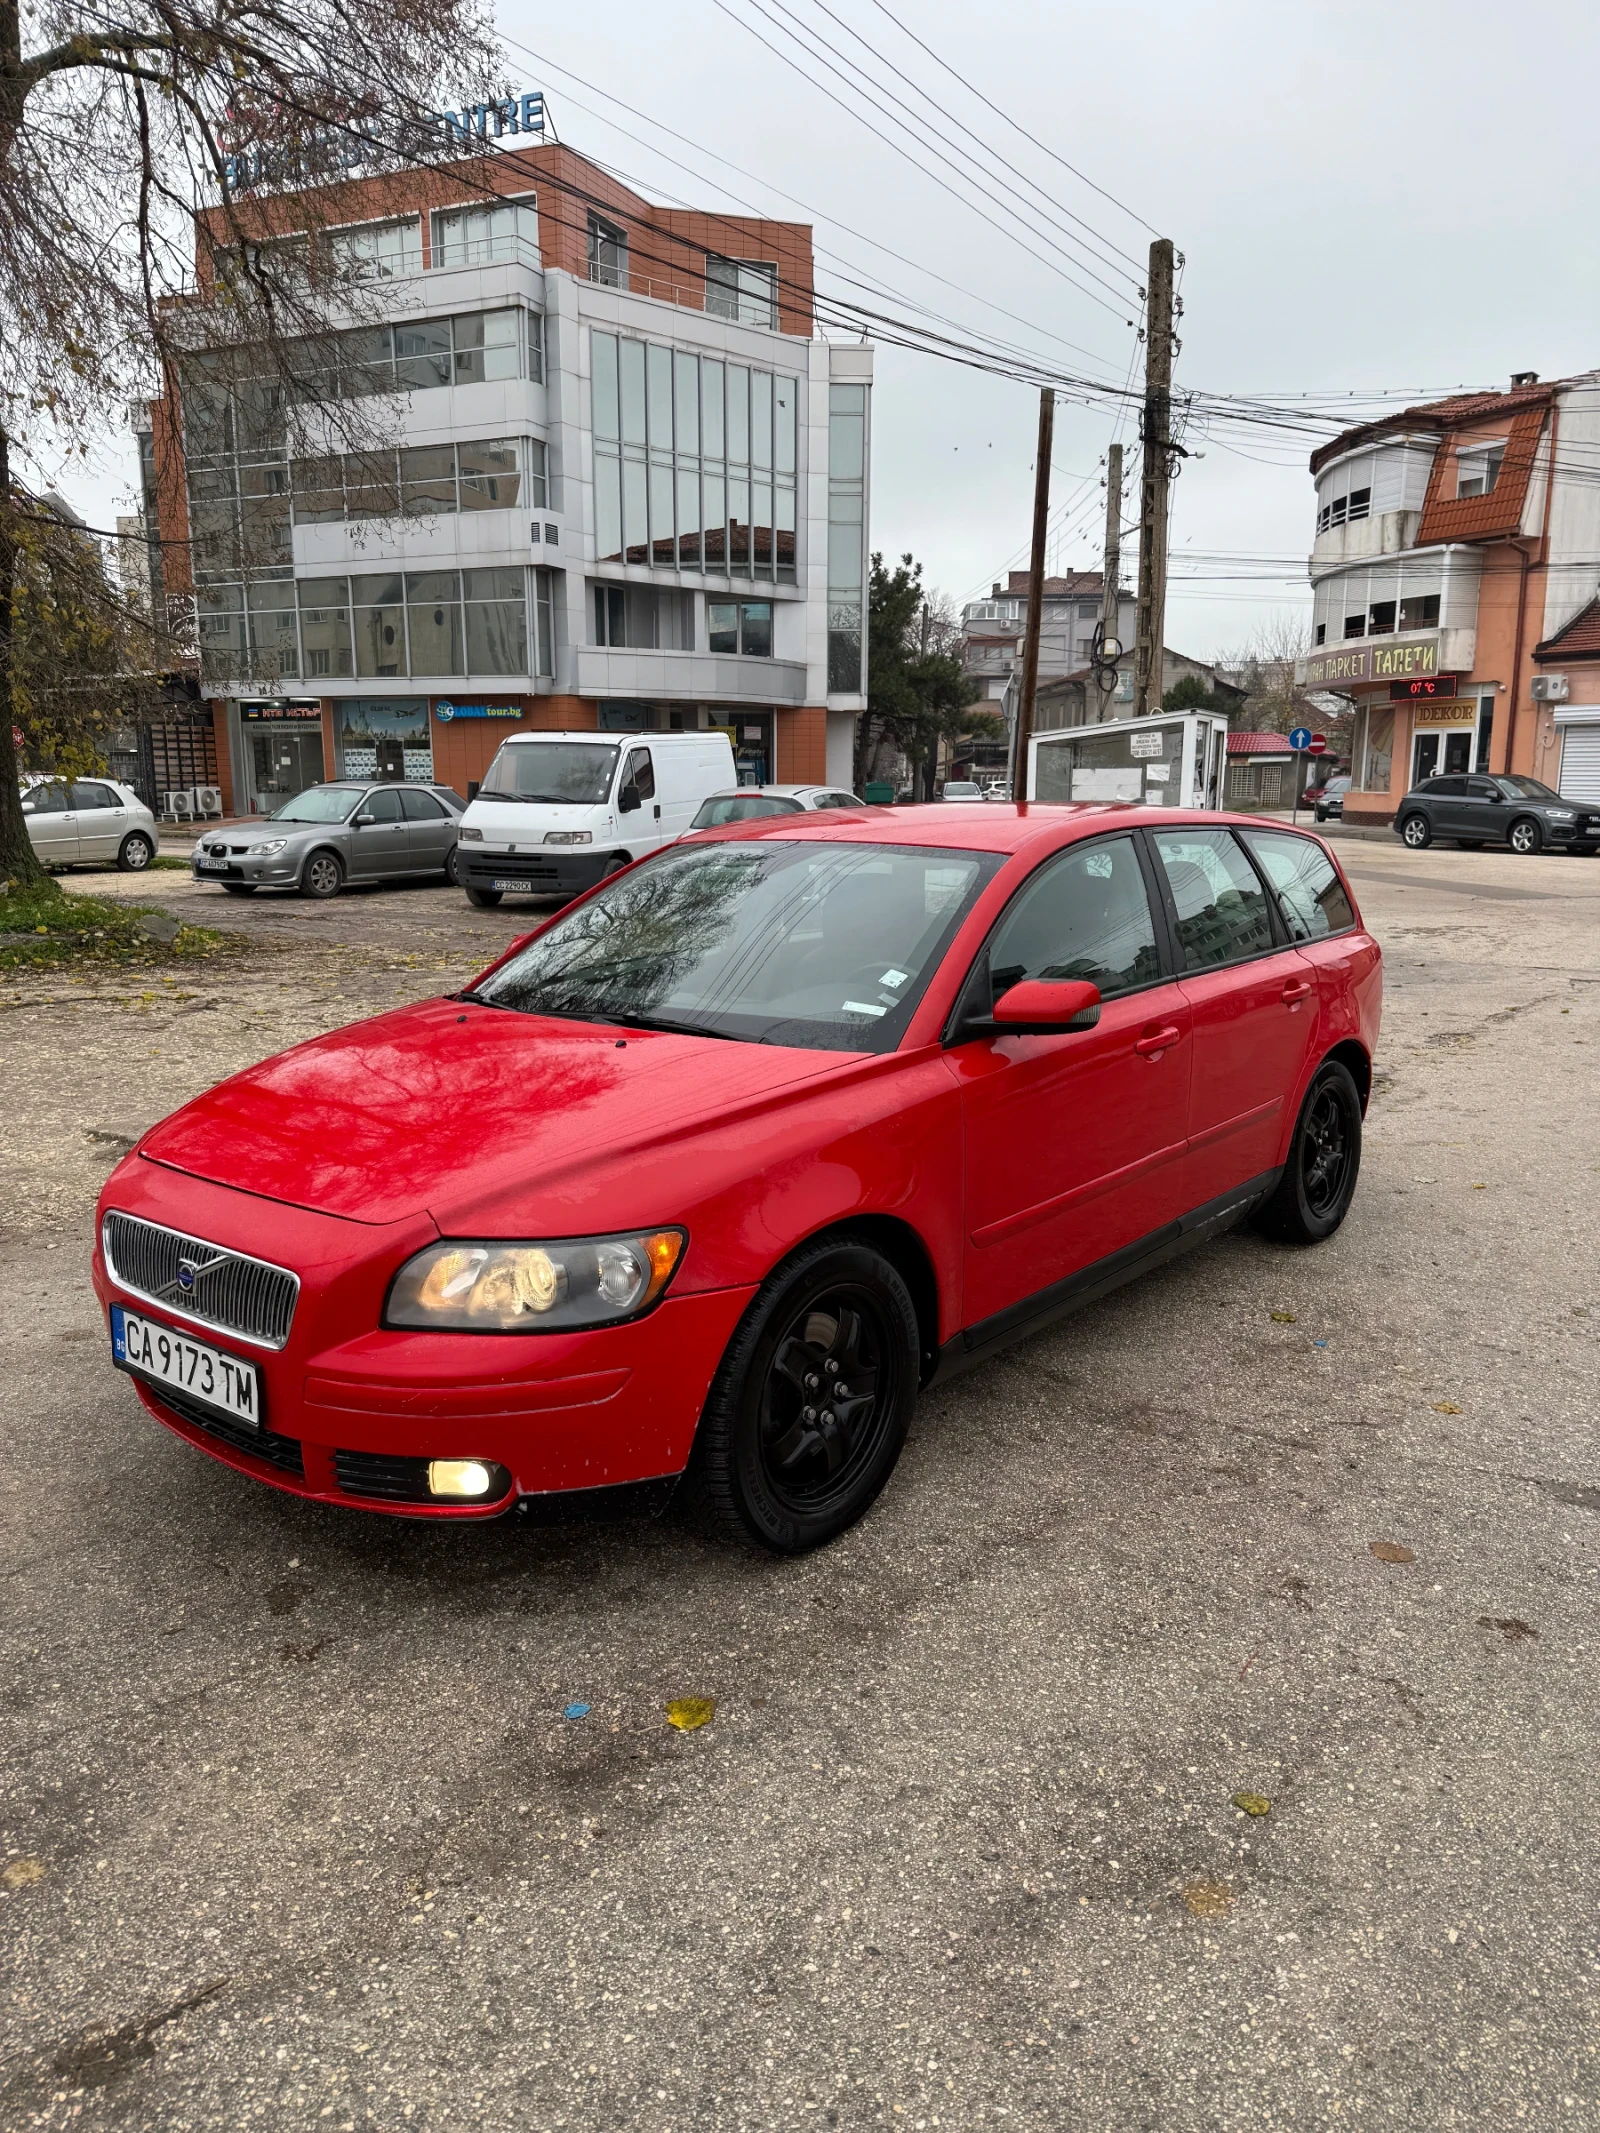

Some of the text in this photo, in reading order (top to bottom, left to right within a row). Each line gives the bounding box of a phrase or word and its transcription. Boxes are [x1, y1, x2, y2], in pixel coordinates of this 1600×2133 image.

[1325, 653, 1366, 680] ПАРКЕТ
[1374, 646, 1434, 674] ТАПЕТИ
[1411, 683, 1421, 693] 07
[1419, 705, 1473, 721] DEKOR
